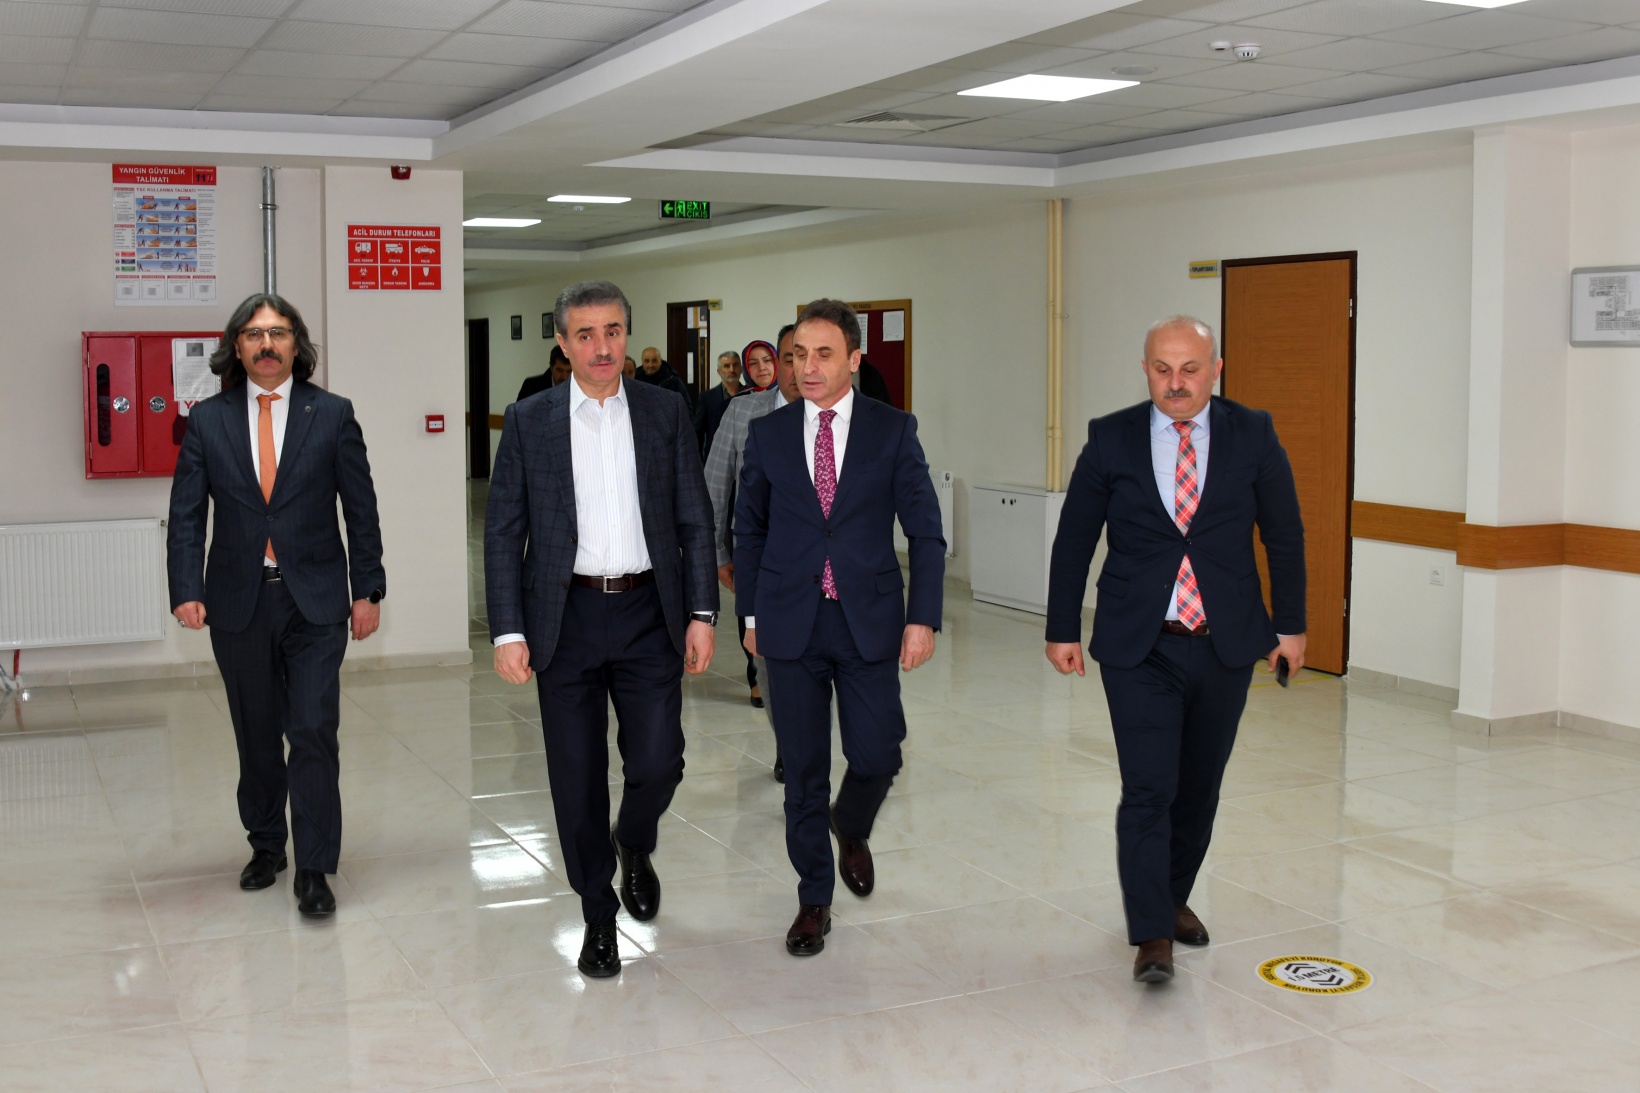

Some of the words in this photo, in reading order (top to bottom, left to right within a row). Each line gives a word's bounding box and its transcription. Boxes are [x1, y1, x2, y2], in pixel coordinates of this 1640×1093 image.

[119, 167, 146, 175] YANGIN
[148, 166, 186, 176] GÜVENLİK
[136, 175, 169, 184] TALİMATI
[687, 201, 707, 210] EXIT
[353, 227, 368, 236] ACİL
